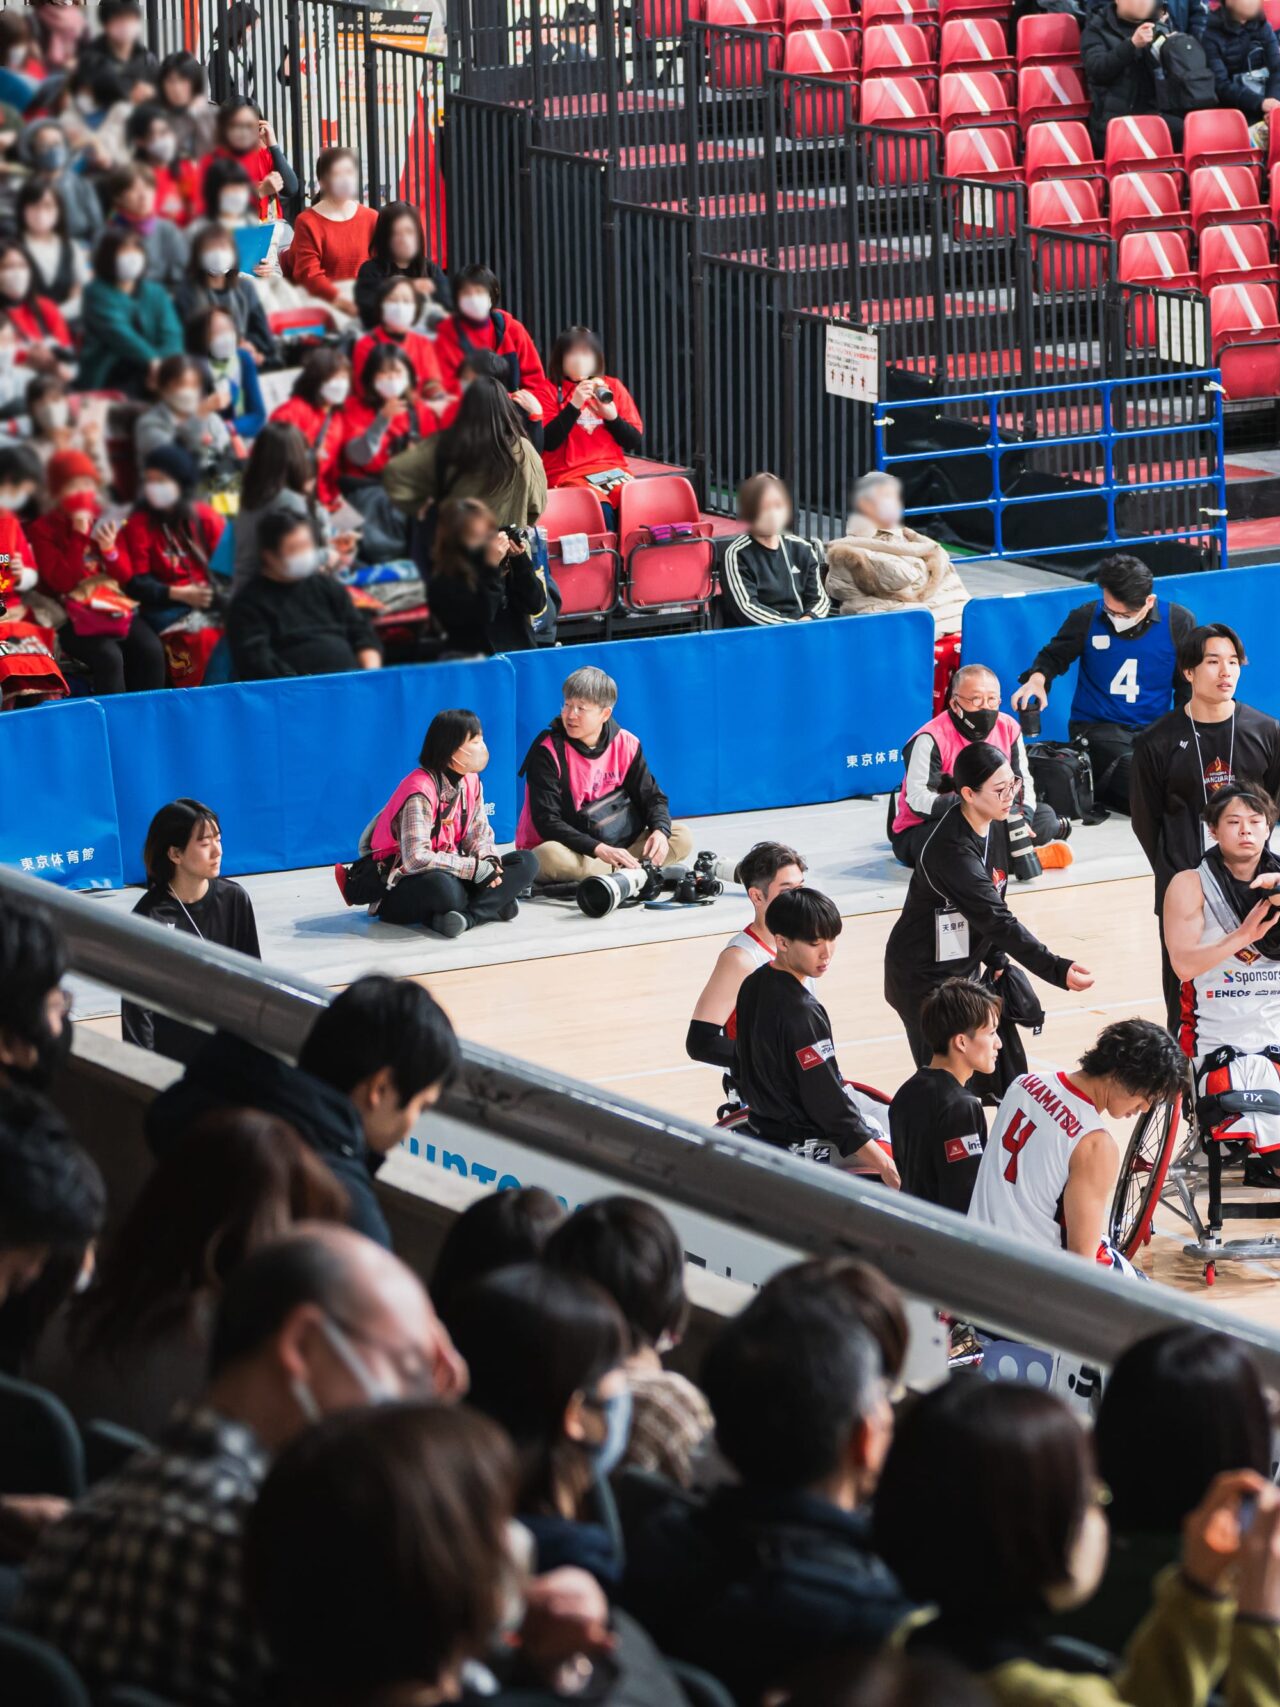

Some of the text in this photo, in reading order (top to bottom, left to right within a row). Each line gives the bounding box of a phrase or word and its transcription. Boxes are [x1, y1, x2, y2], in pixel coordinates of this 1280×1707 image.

[1110, 658, 1140, 704] 4
[846, 748, 904, 769] 東京体育
[19, 847, 95, 871] 東京体育館
[1214, 989, 1252, 999] ENEOS
[1243, 1092, 1264, 1104] FIX
[1001, 1107, 1038, 1186] 4
